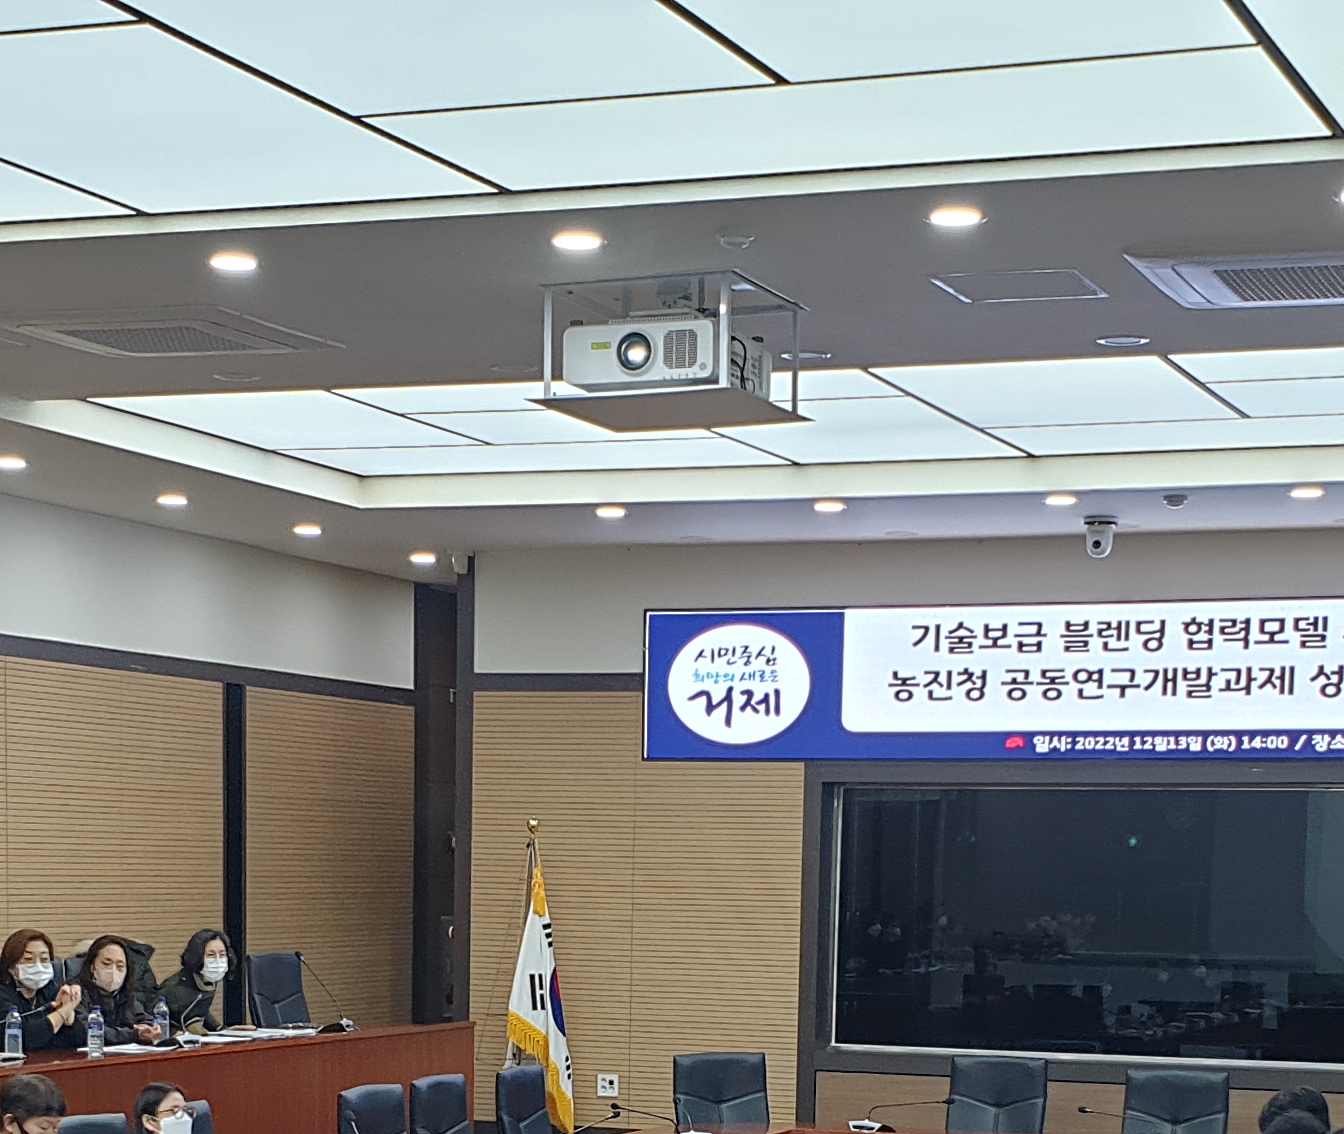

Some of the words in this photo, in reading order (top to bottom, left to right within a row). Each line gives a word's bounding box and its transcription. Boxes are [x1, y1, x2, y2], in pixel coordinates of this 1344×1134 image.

[911, 621, 1047, 654] 기술보급
[1060, 619, 1166, 653] 블렌딩
[1181, 615, 1328, 650] 협력모델
[694, 645, 778, 666] 시민중심
[692, 668, 735, 684] 희망의
[739, 669, 779, 683] 새로운
[888, 667, 987, 702] 농진청
[1001, 664, 1295, 701] 공동연구개발과제
[687, 685, 781, 728] 거제
[1032, 735, 1072, 753] 일시:
[1074, 735, 1129, 751] 2022년
[1132, 735, 1202, 751] 12월13일
[1206, 734, 1236, 751] (화)
[1240, 735, 1288, 750] 14:00
